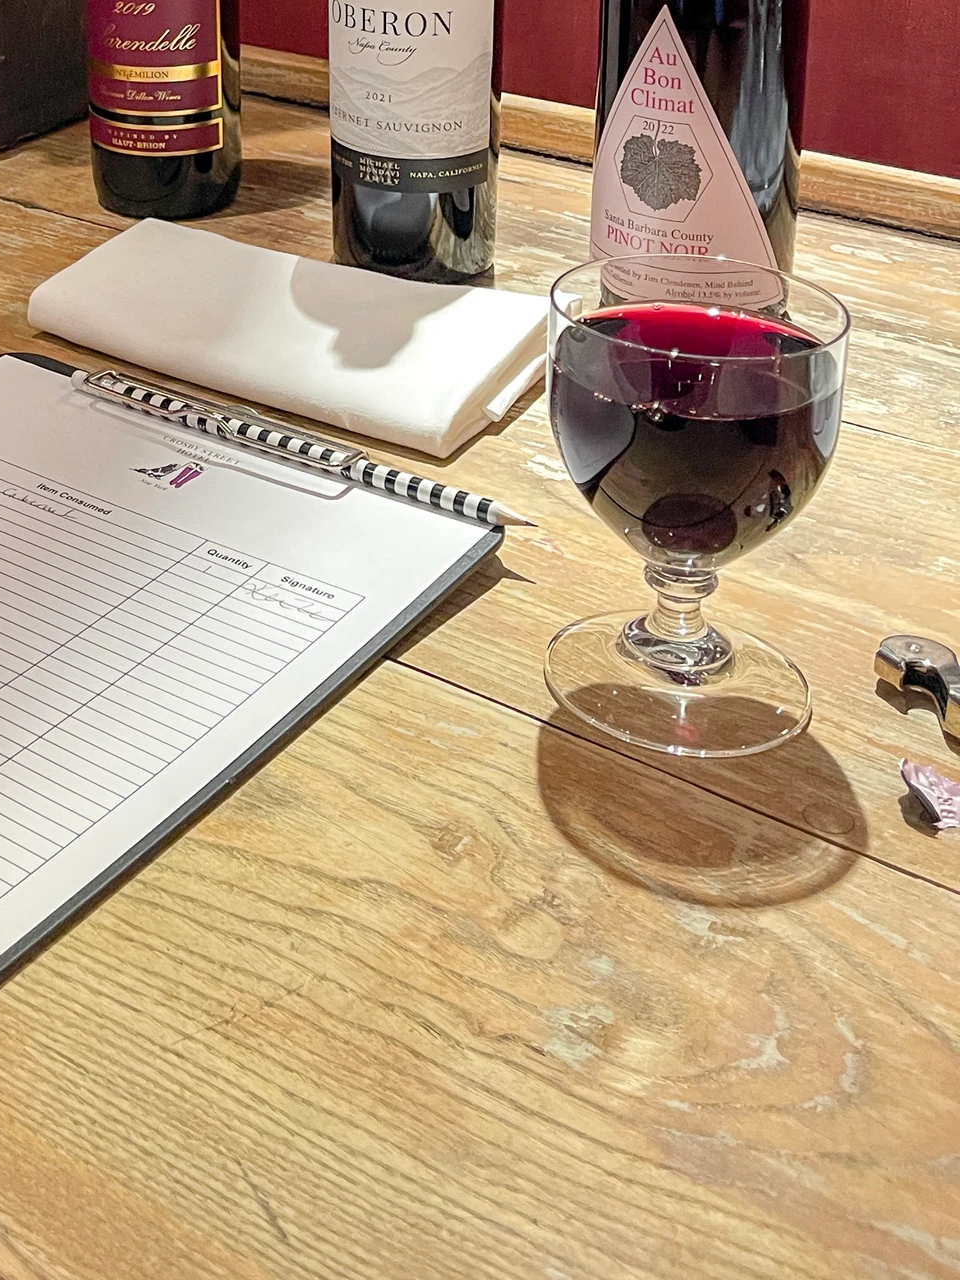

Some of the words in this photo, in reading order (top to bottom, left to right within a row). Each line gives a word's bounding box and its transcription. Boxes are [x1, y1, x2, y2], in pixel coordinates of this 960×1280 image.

[112, 1, 156, 16] 2019
[348, 37, 376, 55] Napa
[377, 40, 418, 66] County
[649, 46, 677, 66] Au
[643, 67, 682, 90] Bon
[365, 91, 393, 103] 2021
[631, 87, 695, 114] Climat
[376, 120, 464, 133] SAUVIGNON
[359, 156, 400, 170] MICHAEL
[359, 164, 400, 178] MONDAVI
[438, 163, 483, 178] CALIFORNIA
[604, 209, 625, 226] Santa
[627, 219, 668, 238] Barbara
[671, 228, 714, 243] County
[607, 224, 655, 253] PINOT
[643, 274, 658, 283] Jim
[705, 281, 725, 289] Mind
[727, 279, 754, 288] Behind
[723, 291, 732, 300] by
[163, 435, 200, 451] CROSBY
[202, 448, 241, 465] STREET
[176, 448, 210, 462] HOTEL
[37, 482, 58, 495] Item
[59, 490, 112, 516] Consumed
[207, 548, 252, 570] Quantity
[280, 575, 335, 600] Signature
